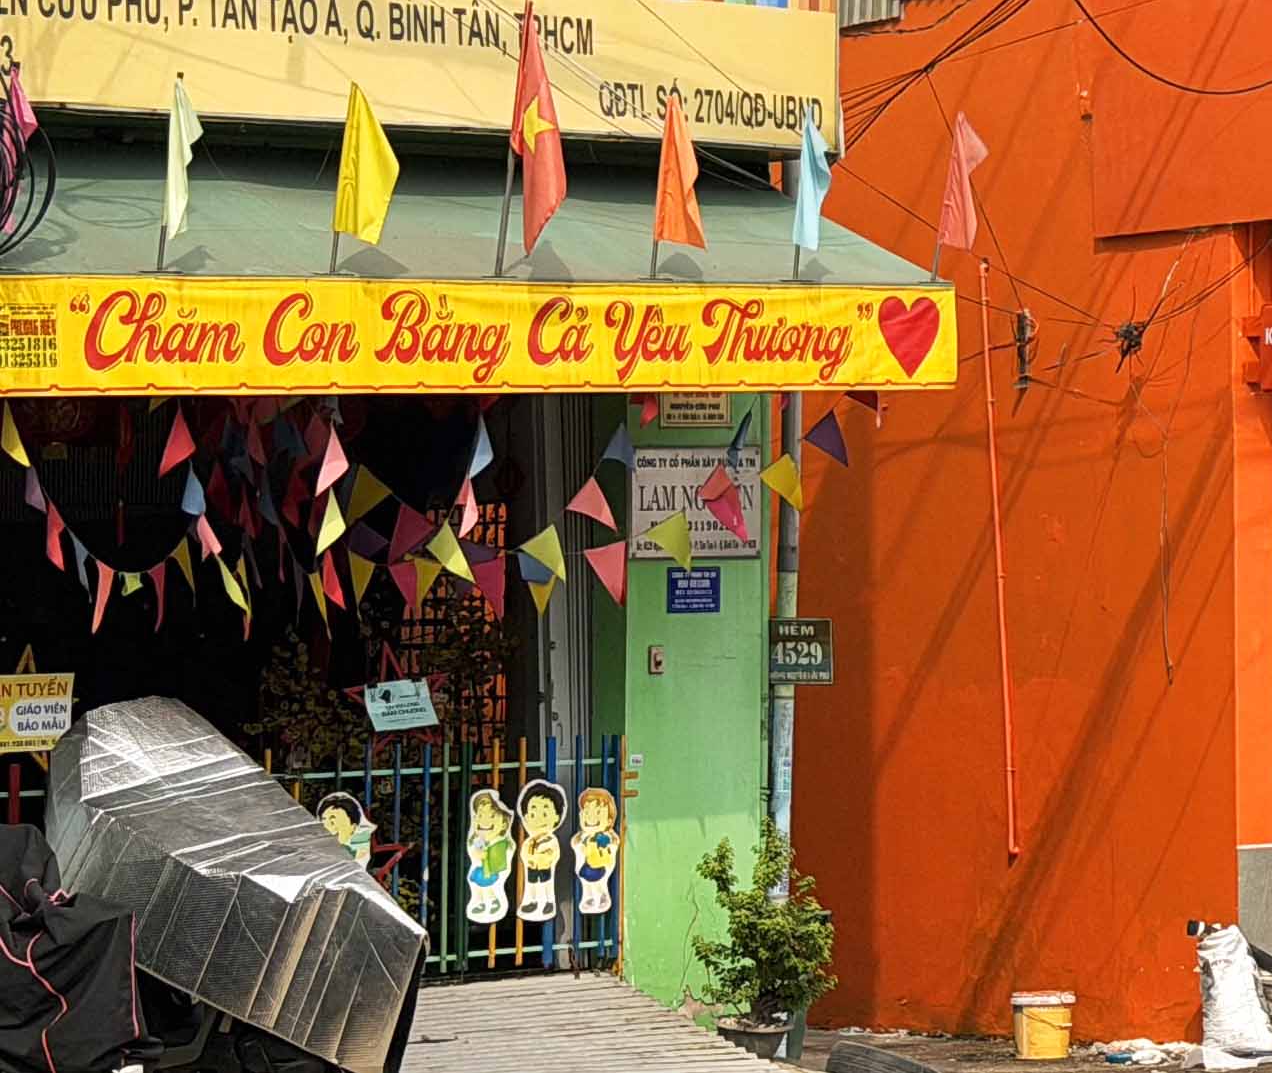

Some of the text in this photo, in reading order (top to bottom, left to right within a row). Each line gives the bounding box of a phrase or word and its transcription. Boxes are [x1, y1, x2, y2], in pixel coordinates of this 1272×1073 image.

[356, 0, 380, 41] Q.
[262, 291, 362, 366] Con
[373, 290, 513, 384] Bằng
[527, 293, 598, 361] Cả
[608, 294, 694, 382] Yêu
[658, 458, 668, 468] TY
[638, 485, 676, 511] LAM
[772, 641, 823, 665] 4529
[16, 676, 68, 697] TUYỂN
